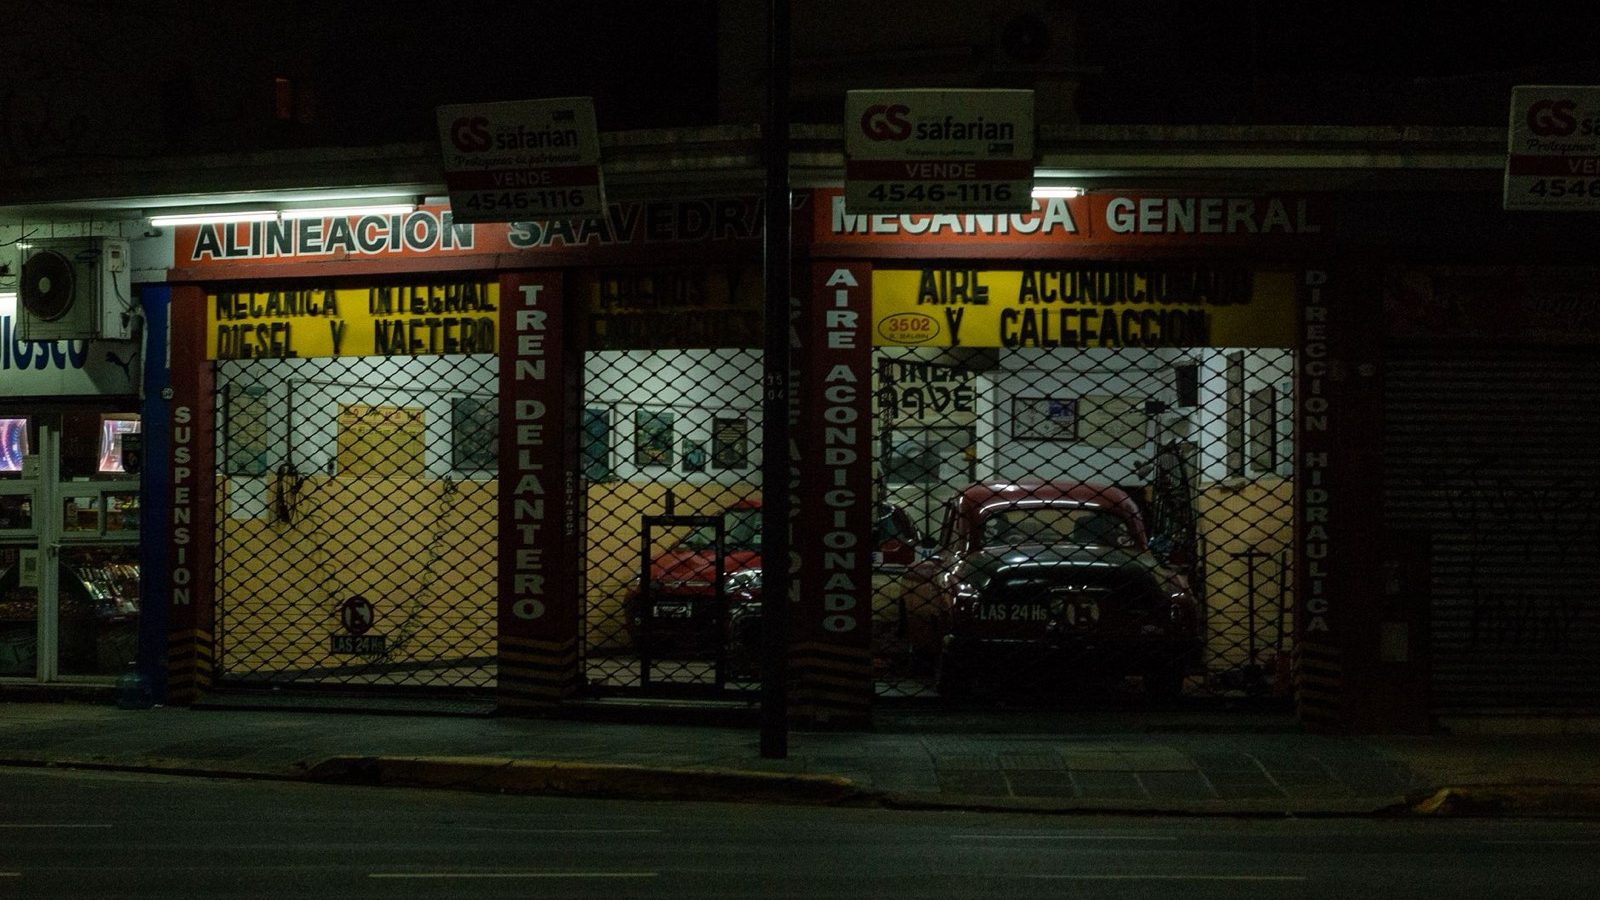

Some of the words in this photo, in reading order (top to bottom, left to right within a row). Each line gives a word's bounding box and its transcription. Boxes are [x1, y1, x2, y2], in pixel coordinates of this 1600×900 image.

[497, 125, 577, 149] safarian
[916, 116, 1014, 140] safarian
[493, 170, 551, 187] VENDE
[905, 163, 976, 178] VENDE
[466, 189, 585, 211] 4546-1116
[868, 184, 1012, 202] 4546-1116
[1105, 197, 1322, 235] GENERAL
[191, 210, 475, 262] ALINEACION
[216, 288, 338, 321] MECANICA
[369, 283, 497, 315] INTEGRAL
[917, 268, 989, 306] AIRE
[1019, 267, 1253, 307] ACONDICIONADO
[825, 268, 860, 349] AIRE
[889, 317, 931, 332] 3502
[945, 306, 964, 347] Y
[1000, 307, 1210, 348] CALEFACCION
[217, 321, 297, 359] DIESEL
[329, 320, 344, 356] Y
[515, 284, 549, 381] TREN
[1305, 269, 1329, 432] DIRECCION
[173, 405, 192, 606] SUSPENSION
[512, 399, 547, 621] DELANTERO
[822, 364, 859, 633] ACONDICIONADO
[1305, 451, 1330, 632] HIDRAULICA
[981, 603, 1008, 620] LAS
[1011, 603, 1029, 621] 24
